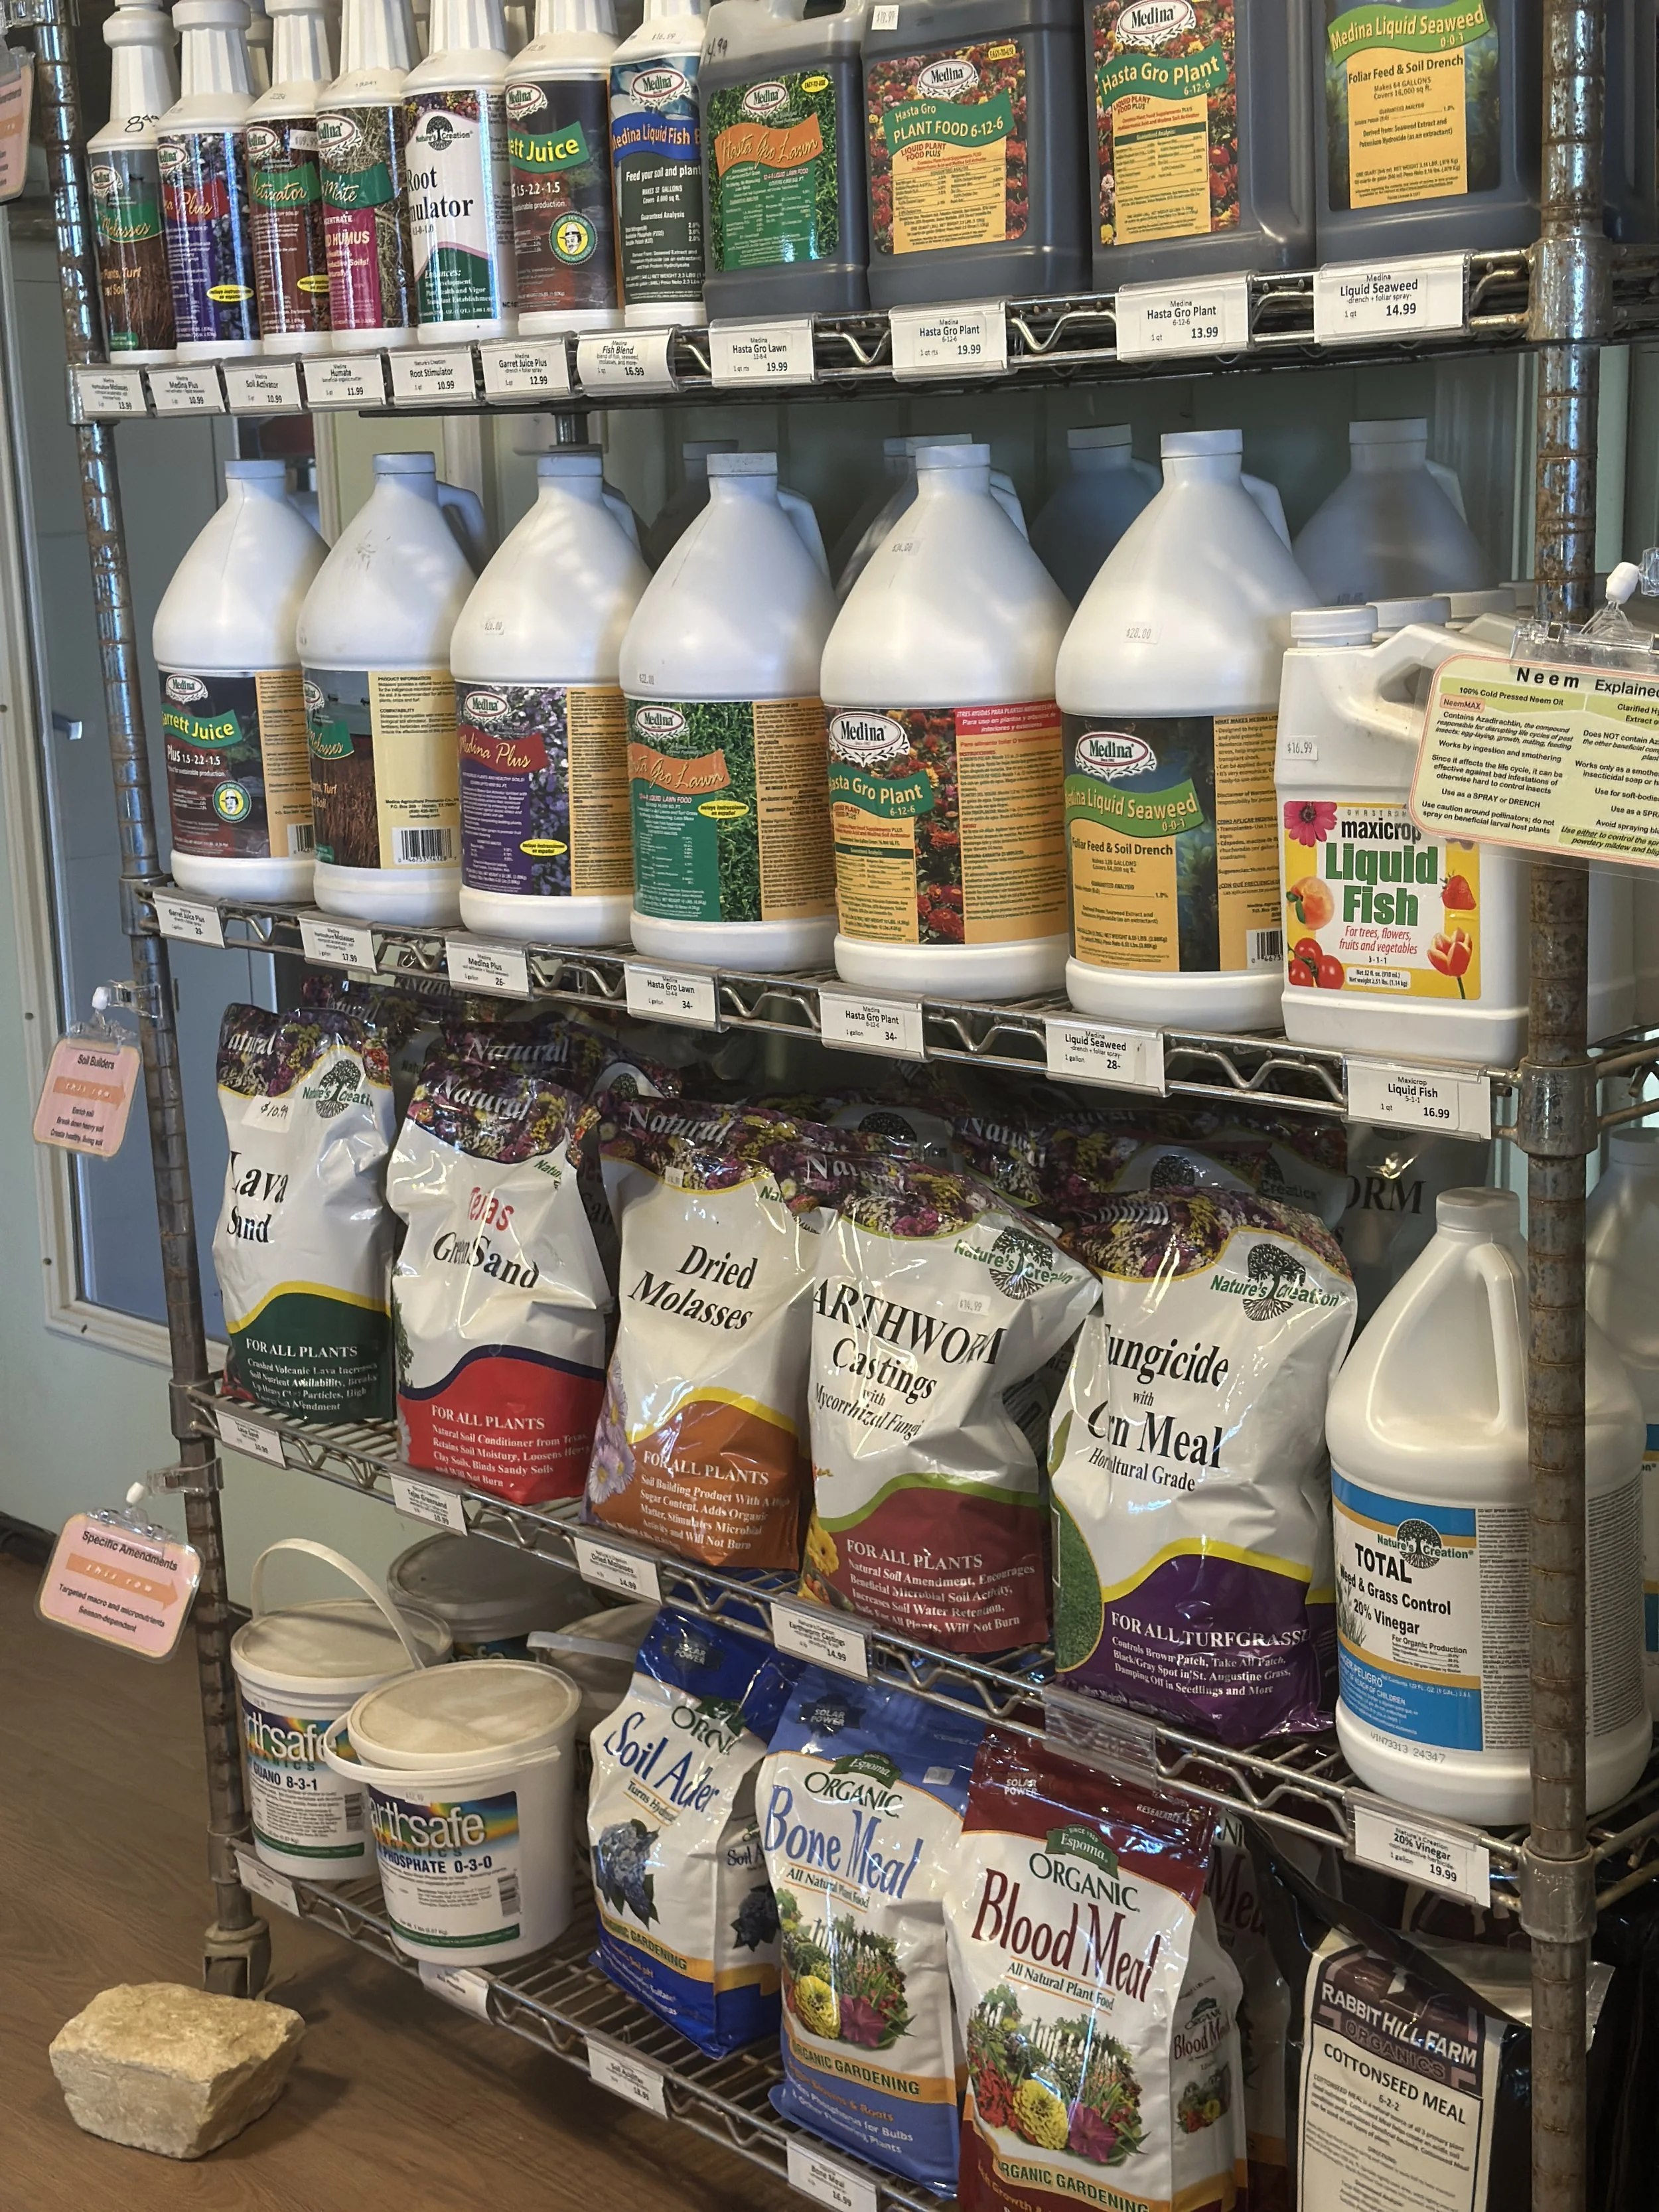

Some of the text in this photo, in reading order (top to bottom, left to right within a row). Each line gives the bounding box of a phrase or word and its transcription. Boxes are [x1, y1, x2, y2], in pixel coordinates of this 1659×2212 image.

[1131, 6, 1174, 27] Medina
[1331, 4, 1484, 51] Medina Liquid Seaweed
[931, 67, 964, 83] Medina
[1102, 57, 1220, 94] Hasta Gro Plant
[1348, 55, 1463, 84] Foliar Feed & Soil Drench
[642, 75, 672, 92] Medina
[753, 88, 780, 104] Medina
[895, 104, 936, 121] Hasta Gro
[643, 124, 690, 145] Liquid Fish
[893, 117, 1004, 143] PLANT FOOD 6-12-6
[526, 138, 580, 163] Juice
[1366, 274, 1391, 283] Medina
[1340, 279, 1418, 298] Liquid Seaweed
[1147, 305, 1216, 321] Hasta Gro Plant
[1386, 303, 1417, 317] 14.99
[920, 325, 979, 336] Hasta Gro Plant
[1191, 327, 1218, 338] 13.99
[603, 345, 634, 354] Fish Blend
[733, 344, 786, 354] Hasta Gro Lawn
[958, 344, 981, 354] 19.99
[499, 358, 547, 368] Garret Juice Plus
[624, 367, 644, 376] 16.99
[767, 362, 788, 372] 19.99
[330, 368, 352, 378] Humate
[410, 368, 453, 378] Root Stimulator
[530, 376, 547, 386] 12.99
[347, 387, 364, 396] 11.99
[437, 381, 455, 390] 10.99
[1516, 667, 1580, 689] Neem
[1460, 687, 1478, 696] 100%
[1480, 689, 1498, 698] Cold
[1500, 692, 1528, 702] Pressed
[1530, 694, 1548, 704] Neem
[472, 698, 498, 714] Medina
[1444, 699, 1481, 710] NeemMAX
[643, 712, 674, 727] Medina
[190, 720, 235, 741] Juice
[840, 720, 885, 742] Medina
[1088, 739, 1132, 759] Medina
[1287, 739, 1313, 755] $16.99
[852, 778, 924, 806] Gro Plant
[1442, 788, 1455, 797] Use
[1473, 793, 1498, 803] SPRAY
[1508, 796, 1540, 808] DRENCH
[889, 805, 916, 817] 6-12-6
[1088, 788, 1198, 820] Liquid Seaweed
[1342, 818, 1421, 844] maxicrop
[1072, 837, 1173, 855] Foliar Feed & Soil Drench
[1325, 843, 1438, 885] Liquid
[1343, 885, 1418, 926] Fish
[1345, 925, 1411, 941] For trees, flowers,
[1339, 939, 1417, 955] fruits and vegetables
[469, 958, 502, 971] Medina Plus
[496, 978, 506, 986] 26-
[648, 980, 695, 994] Hasta Gro Lawn
[682, 1000, 693, 1009] 34-
[845, 1010, 899, 1025] Hasta Gro Plant
[885, 1031, 897, 1041] 34-
[1065, 1034, 1127, 1051] Liquid Seaweed
[78, 1054, 114, 1070] Soil Builders
[1107, 1059, 1121, 1070] 28-
[1398, 1076, 1427, 1086] Maxicrop
[1388, 1084, 1438, 1098] Liquid Fish
[1423, 1107, 1450, 1118] 16.99
[676, 1245, 757, 1290] Dried
[628, 1271, 753, 1331] Molasses
[246, 1338, 358, 1358] FOR ALL PLANTS
[832, 1337, 937, 1404] Castings
[431, 1404, 545, 1430] FOR ALL PLANTS
[1137, 1412, 1222, 1468] Meal
[82, 1530, 177, 1571] Specific Amendments
[1355, 1542, 1412, 1584] TOTAL
[1359, 1578, 1451, 1615] & Grass Control
[1354, 1599, 1420, 1635] 20% Vinegar
[850, 1755, 891, 1775] Espoma
[286, 1776, 319, 1791] 8-3-1
[804, 1770, 901, 1819] ORGANIC
[764, 1785, 923, 1899] Bone Meal
[1060, 1832, 1106, 1860] Espoma
[1394, 1834, 1451, 1860] 20% Vinegar
[384, 1850, 492, 1874] PHOSPHATE 0-3-0
[1430, 1864, 1457, 1882] 19.99
[1029, 1852, 1140, 1913] ORGANIC
[972, 1868, 1161, 2002] Blood Meal
[1008, 1962, 1114, 2010] All Natural Plant Food
[1322, 1982, 1477, 2068] RABBIT HILL FARM
[1325, 2043, 1465, 2124] COTTONSEED MEAL
[1378, 2095, 1400, 2111] 6-2-2
